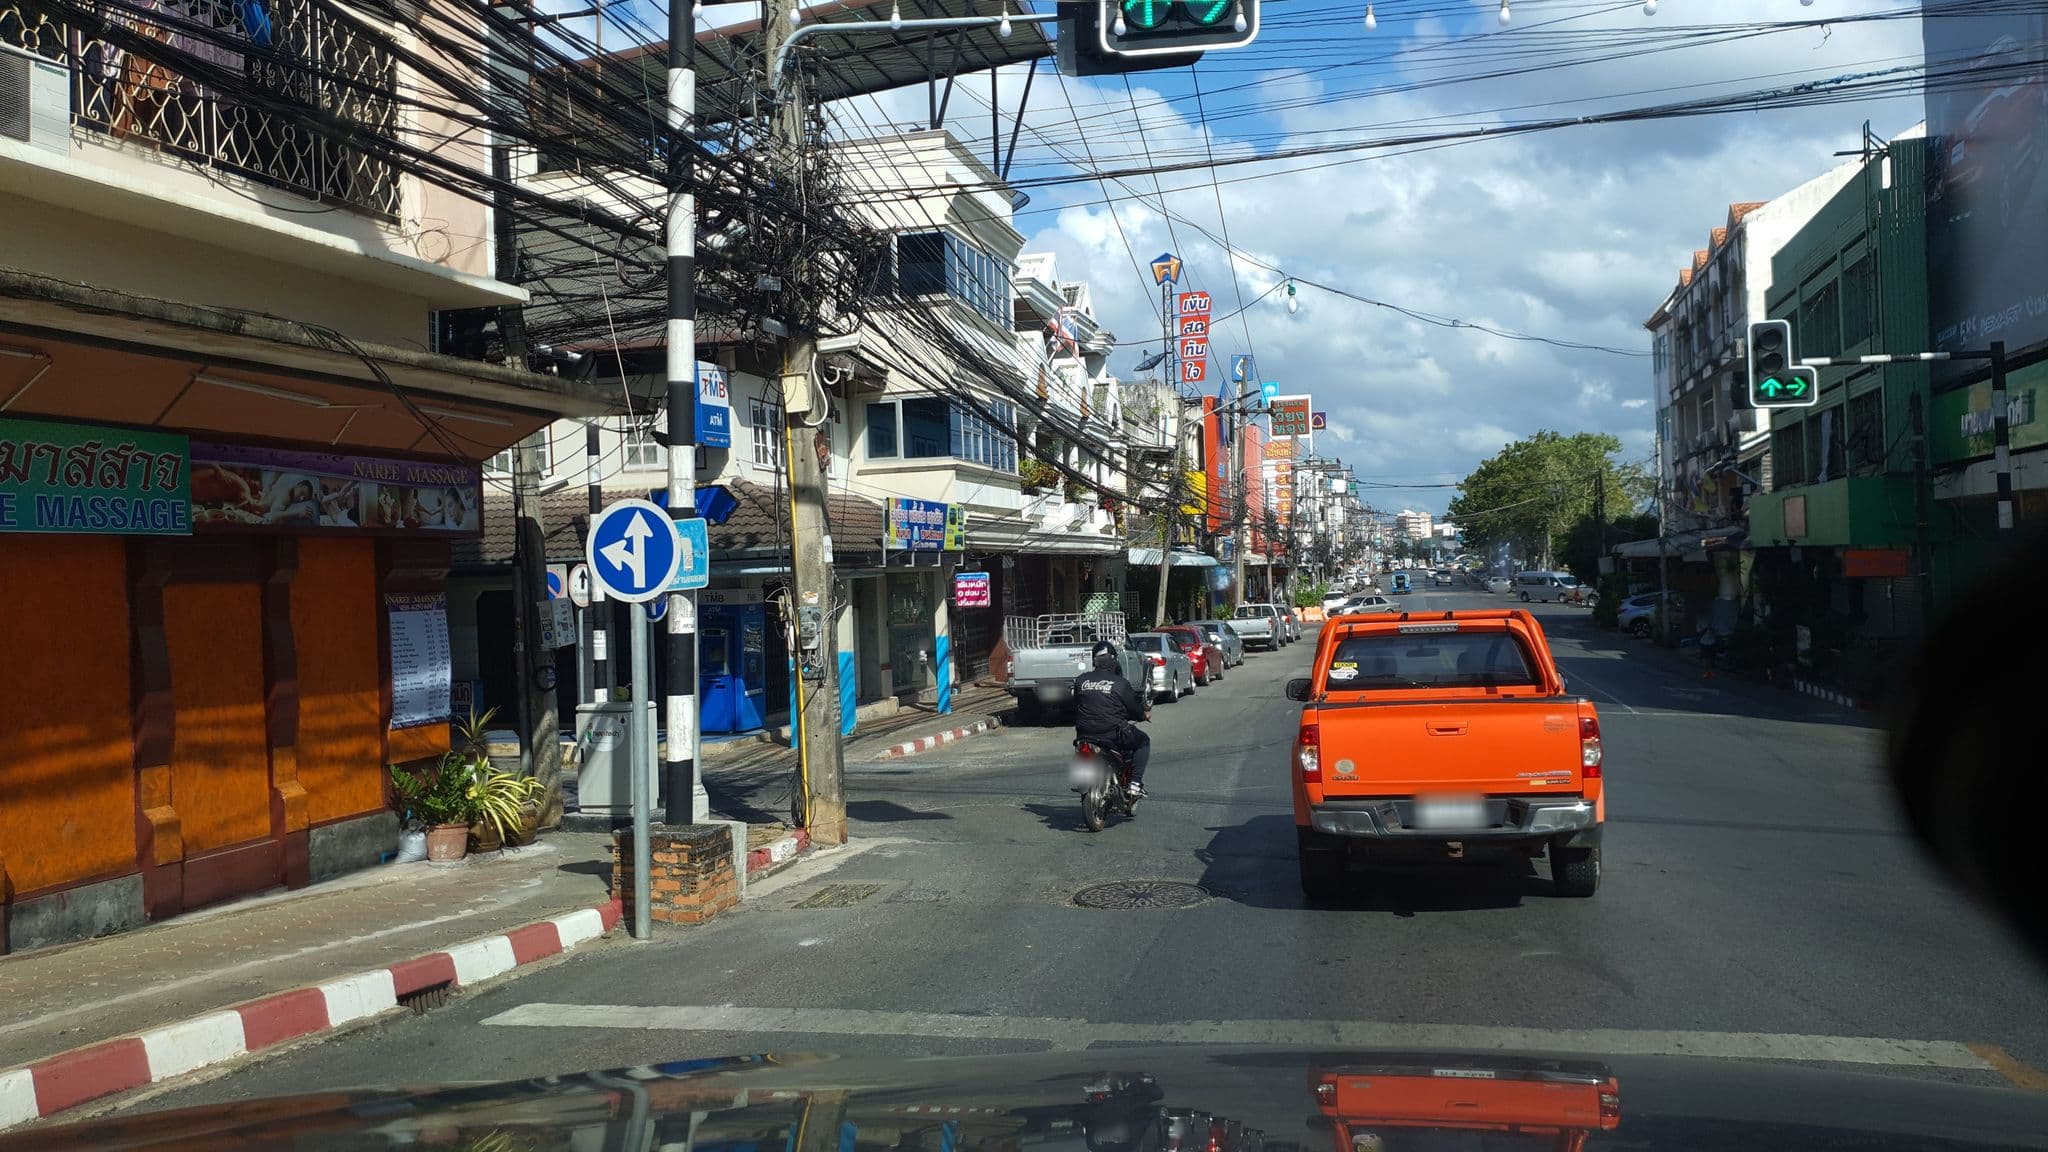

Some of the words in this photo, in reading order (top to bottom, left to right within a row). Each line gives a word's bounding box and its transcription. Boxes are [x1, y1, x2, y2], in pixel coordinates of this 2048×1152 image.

[1183, 295, 1210, 312] เงิน
[1183, 320, 1206, 335] สด
[1185, 361, 1201, 380] ใจ
[702, 374, 726, 398] TMB
[709, 413, 723, 427] ATM
[353, 461, 400, 480] NAREE
[407, 467, 468, 484] MASSAGE
[36, 494, 187, 530] MASSAGE
[704, 592, 725, 603] TMB
